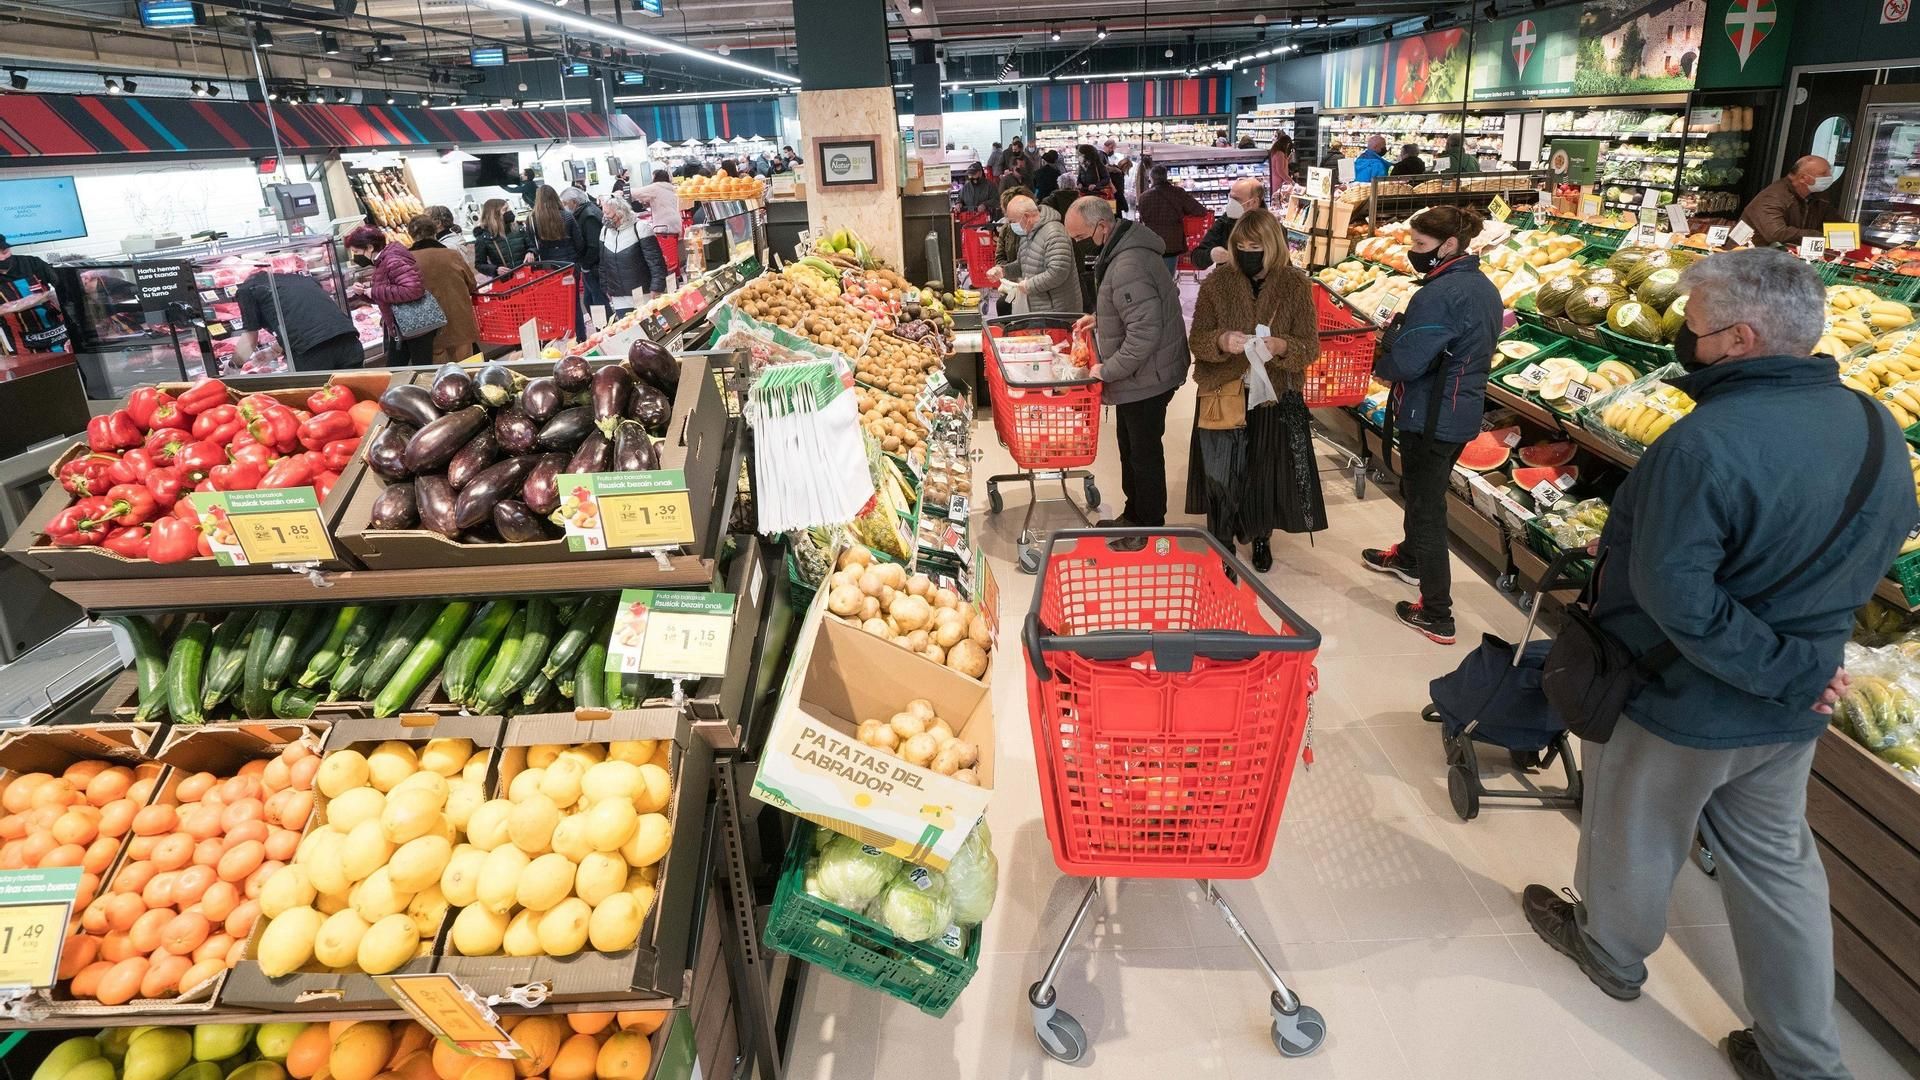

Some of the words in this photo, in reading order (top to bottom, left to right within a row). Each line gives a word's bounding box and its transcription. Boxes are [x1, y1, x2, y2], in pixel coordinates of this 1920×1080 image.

[285, 497, 305, 505] onak
[791, 743, 895, 796] LABRADOR
[800, 727, 890, 775] PATATAS
[891, 767, 925, 791] DEL
